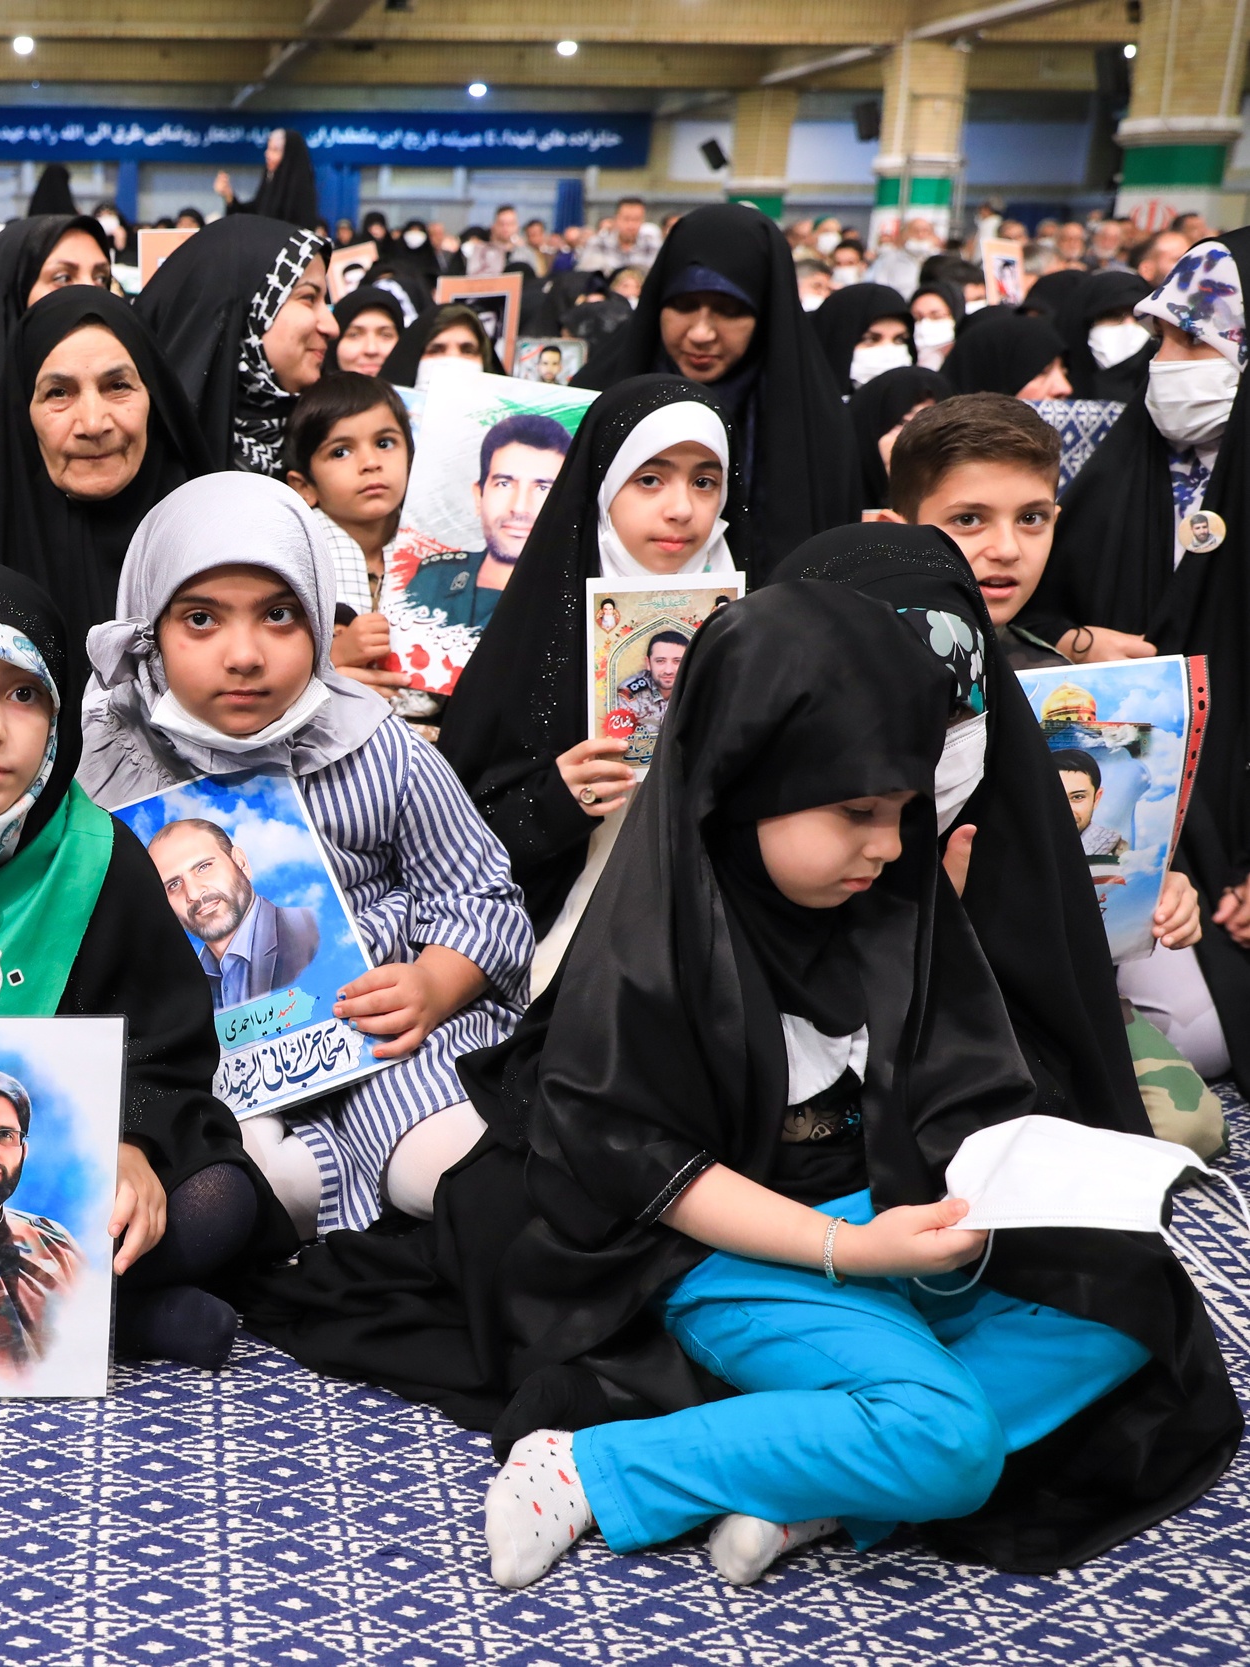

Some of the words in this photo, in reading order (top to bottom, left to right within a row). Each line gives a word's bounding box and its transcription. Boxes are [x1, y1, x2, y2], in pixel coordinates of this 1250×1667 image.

[256, 1006, 282, 1037] پوریا
[277, 989, 297, 1028] شهید
[225, 1017, 255, 1042] احمدی
[284, 1036, 351, 1089] اصحاب
